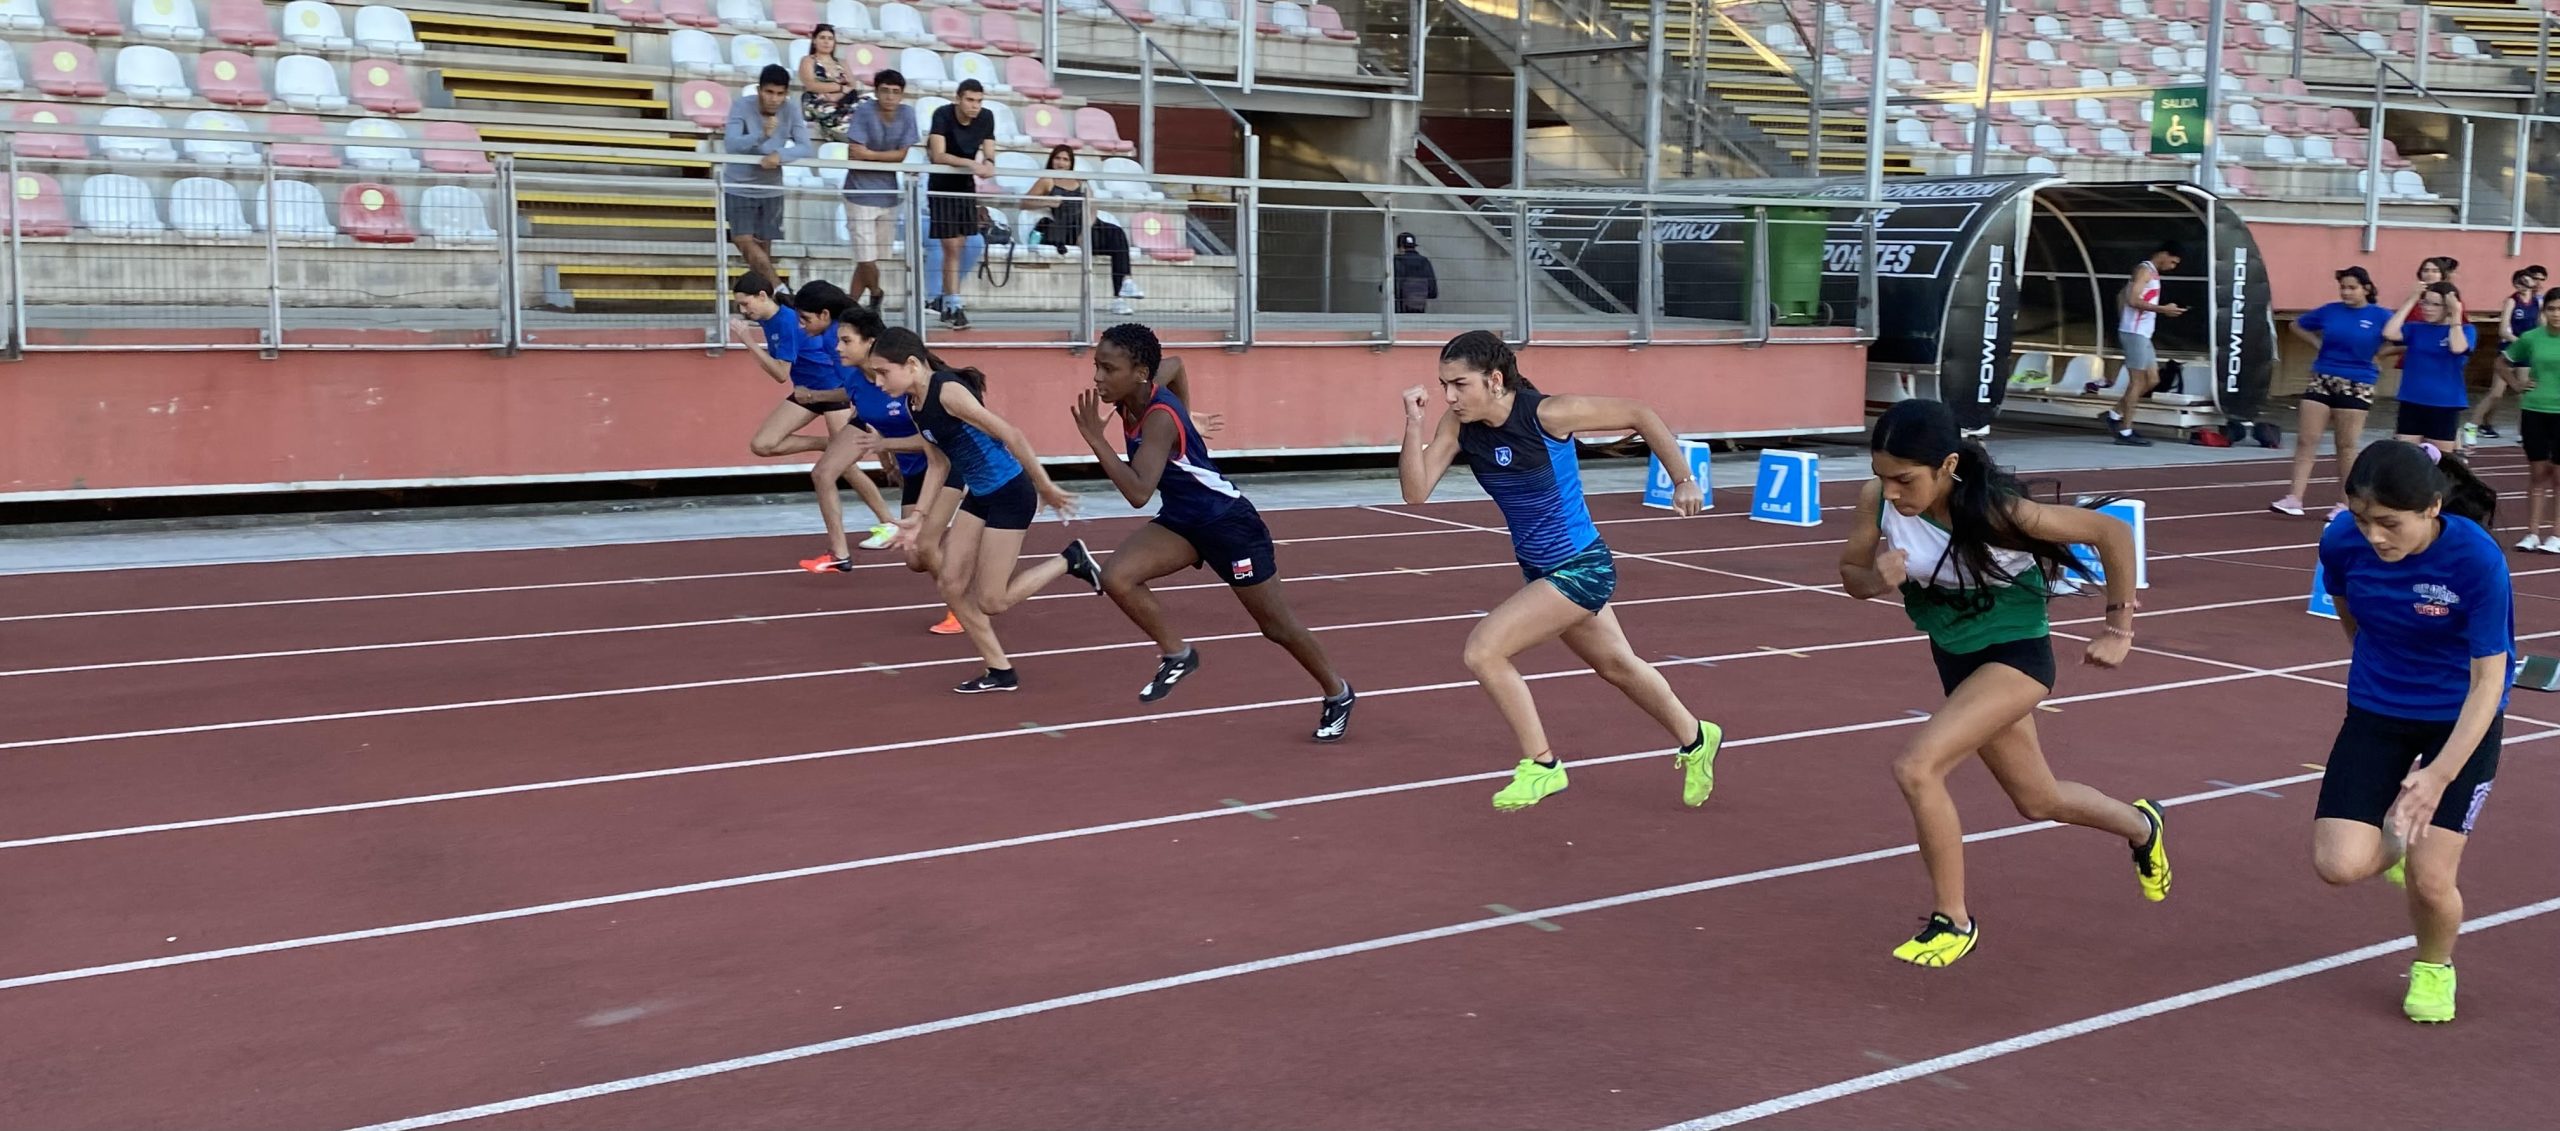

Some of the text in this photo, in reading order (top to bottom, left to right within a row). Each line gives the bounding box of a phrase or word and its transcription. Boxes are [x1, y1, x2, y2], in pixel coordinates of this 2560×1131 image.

[2161, 98, 2199, 109] SALIDA
[1819, 181, 2000, 198] CORORACION
[1977, 244, 2004, 403] POWERADE
[2226, 247, 2247, 393] POWERADE
[1768, 464, 1789, 499] 7
